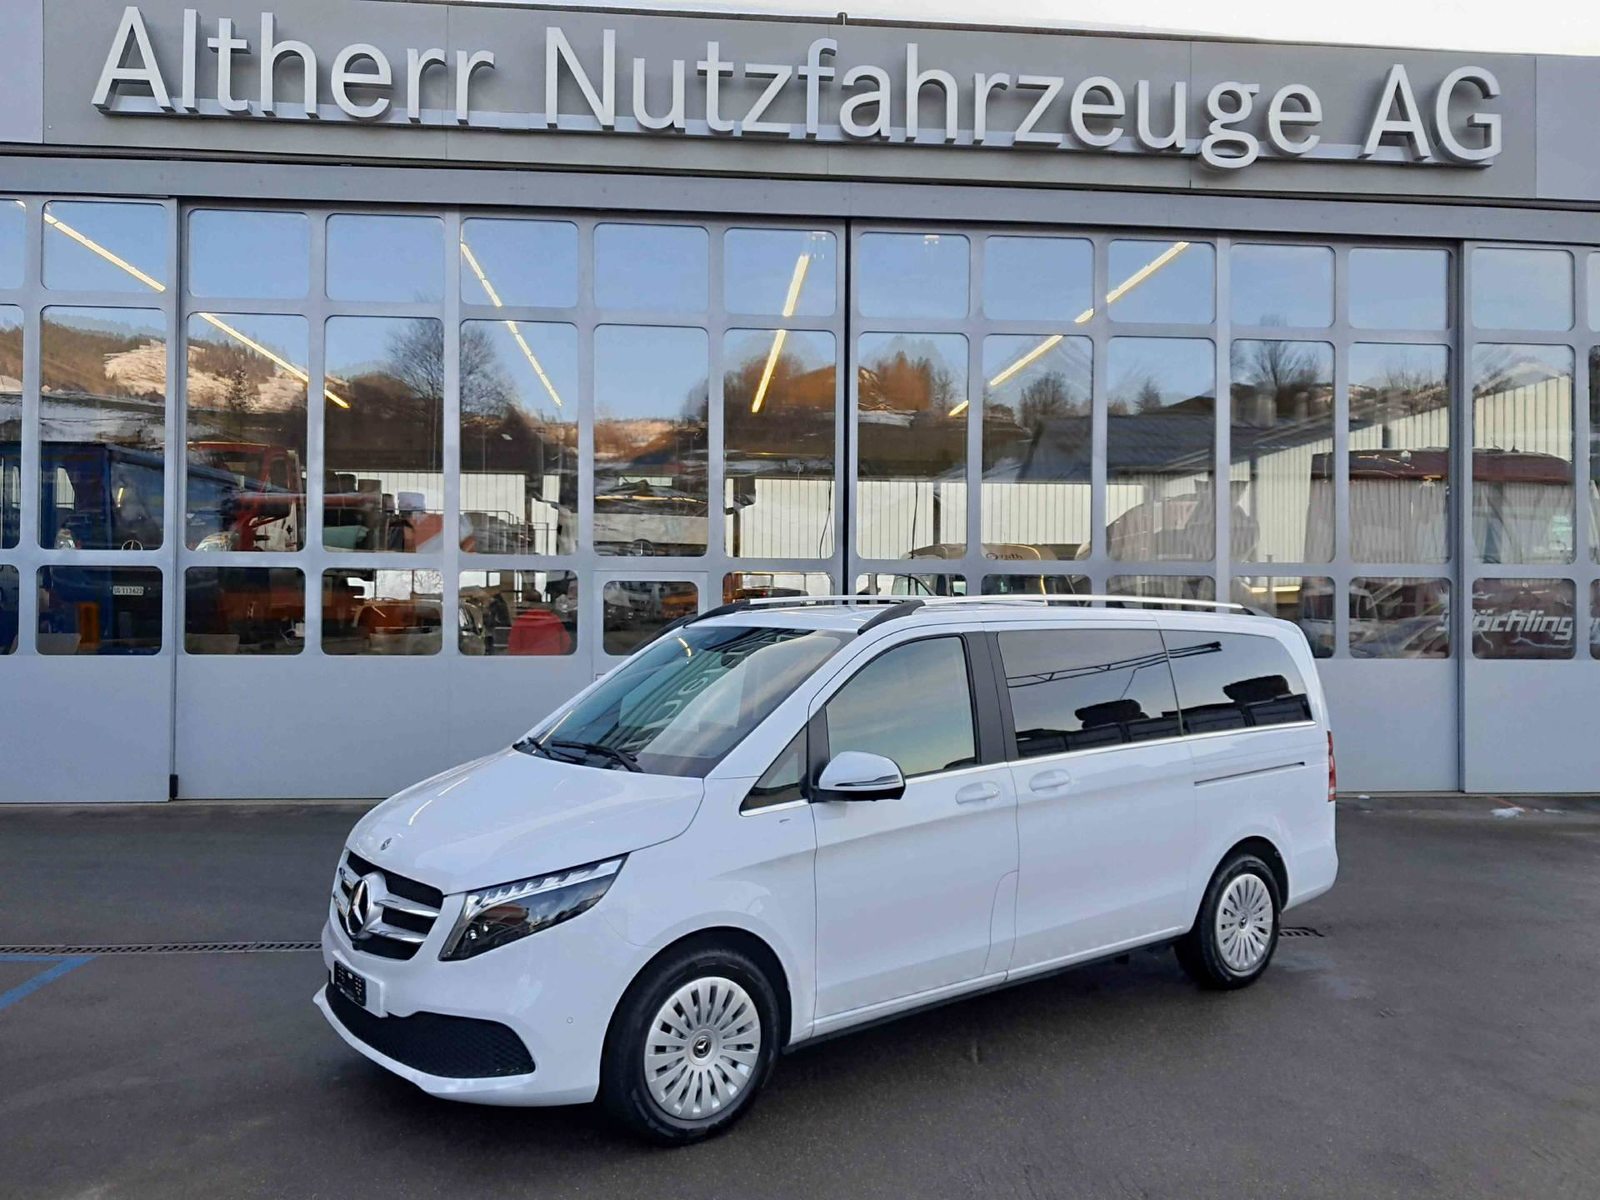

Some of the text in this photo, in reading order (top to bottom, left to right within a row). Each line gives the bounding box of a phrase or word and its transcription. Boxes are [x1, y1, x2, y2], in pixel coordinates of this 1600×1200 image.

[91, 6, 1502, 170] Altherr Nutzfahrzeuge AG
